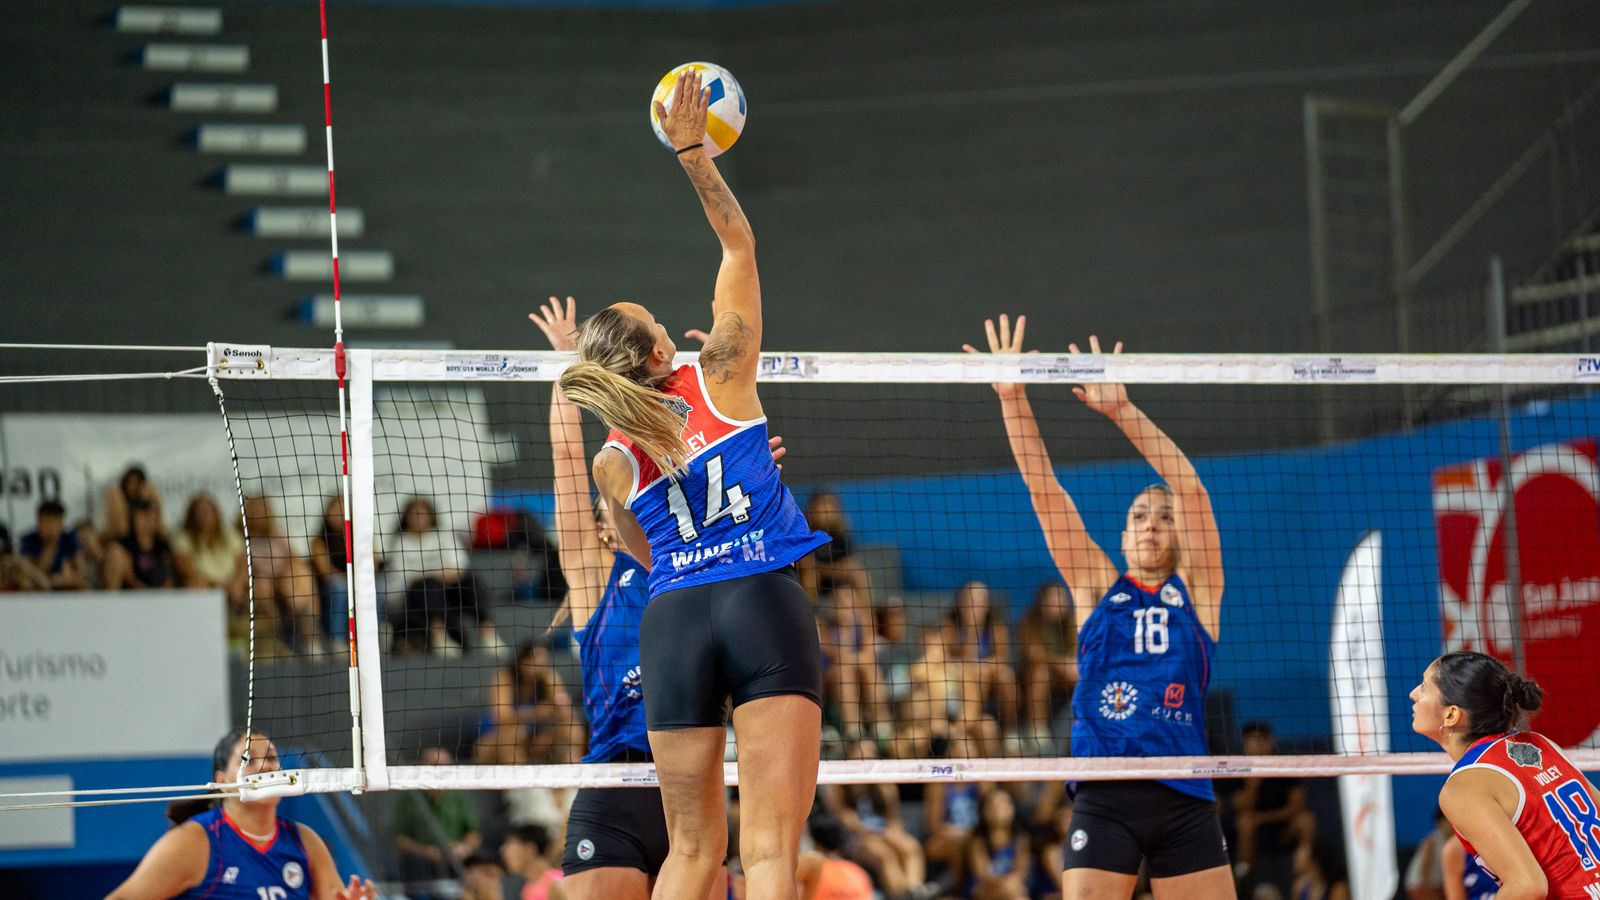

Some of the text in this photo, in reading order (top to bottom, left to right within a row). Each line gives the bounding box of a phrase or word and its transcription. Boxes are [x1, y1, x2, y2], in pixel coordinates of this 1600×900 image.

[231, 349, 262, 357] Senoh
[0, 467, 61, 501] an
[667, 452, 752, 544] 14
[1133, 606, 1169, 654] 18
[1533, 765, 1562, 786] VOLEY
